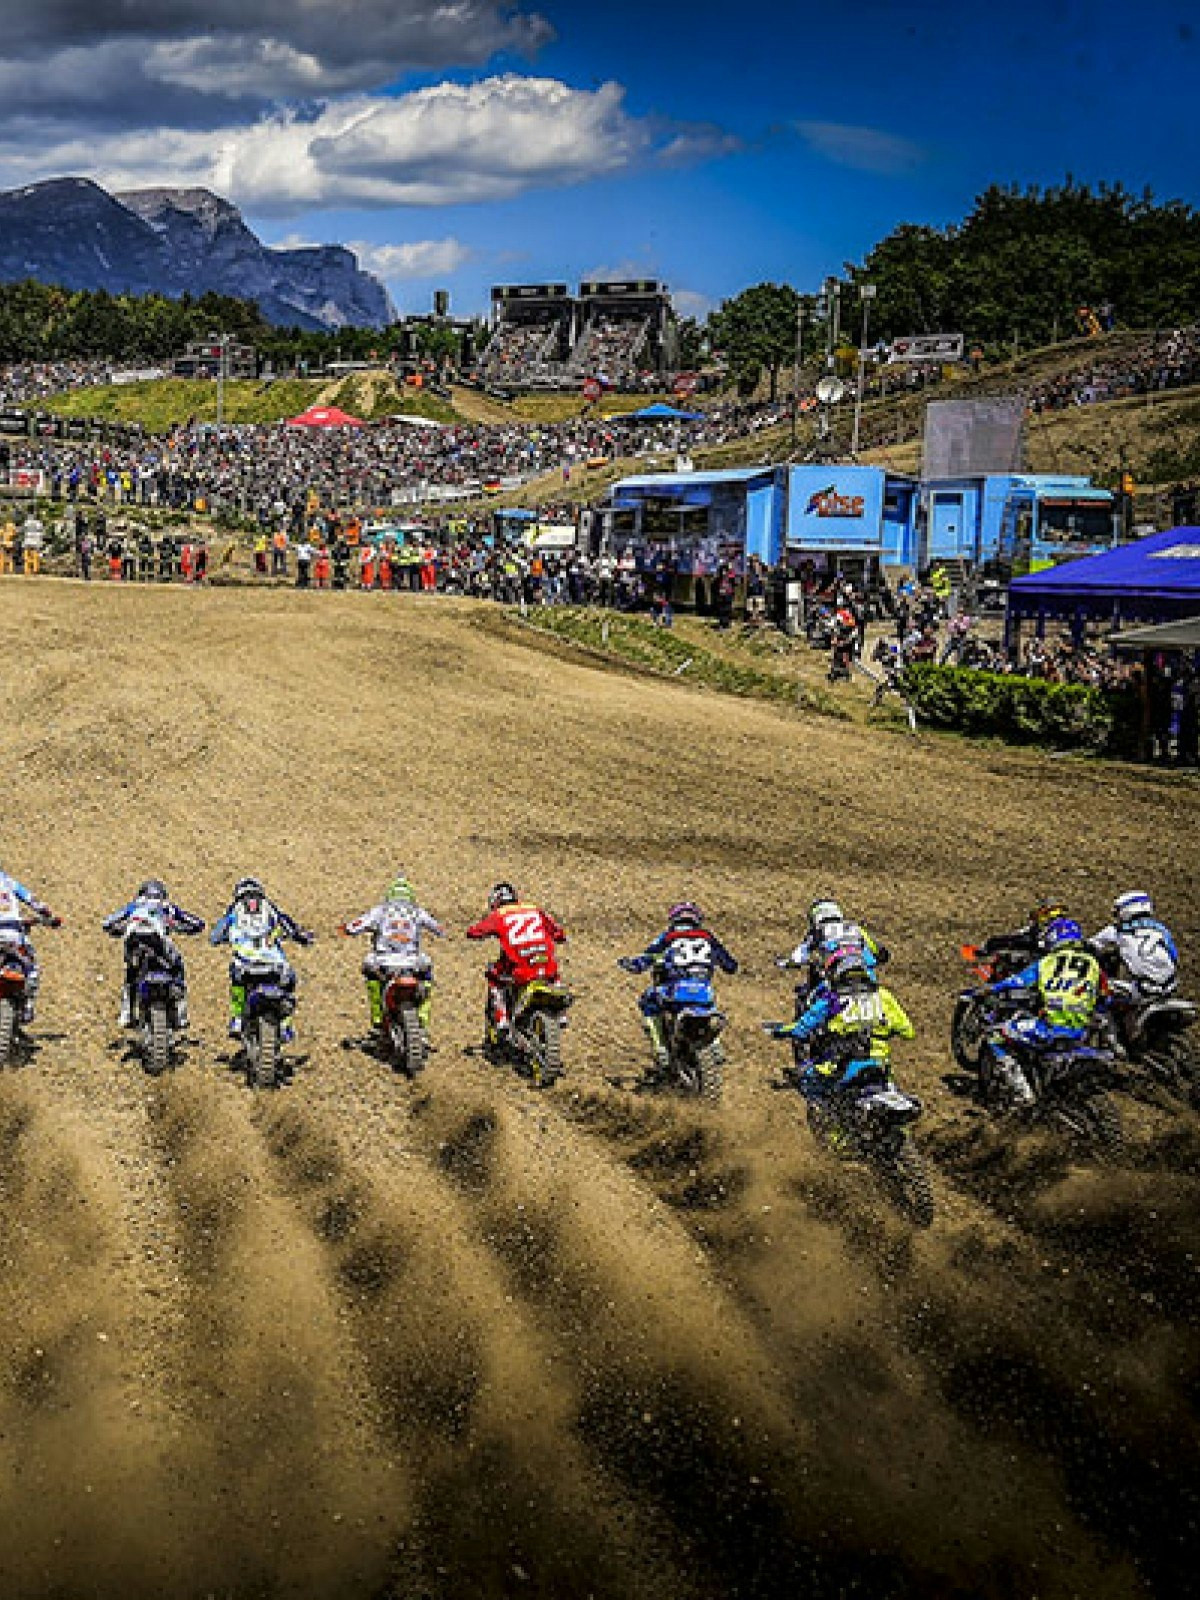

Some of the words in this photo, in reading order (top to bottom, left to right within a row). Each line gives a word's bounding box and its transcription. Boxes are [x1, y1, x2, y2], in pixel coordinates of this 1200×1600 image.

[505, 913, 545, 945] 22
[672, 938, 712, 965] 32
[1053, 954, 1091, 979] 19
